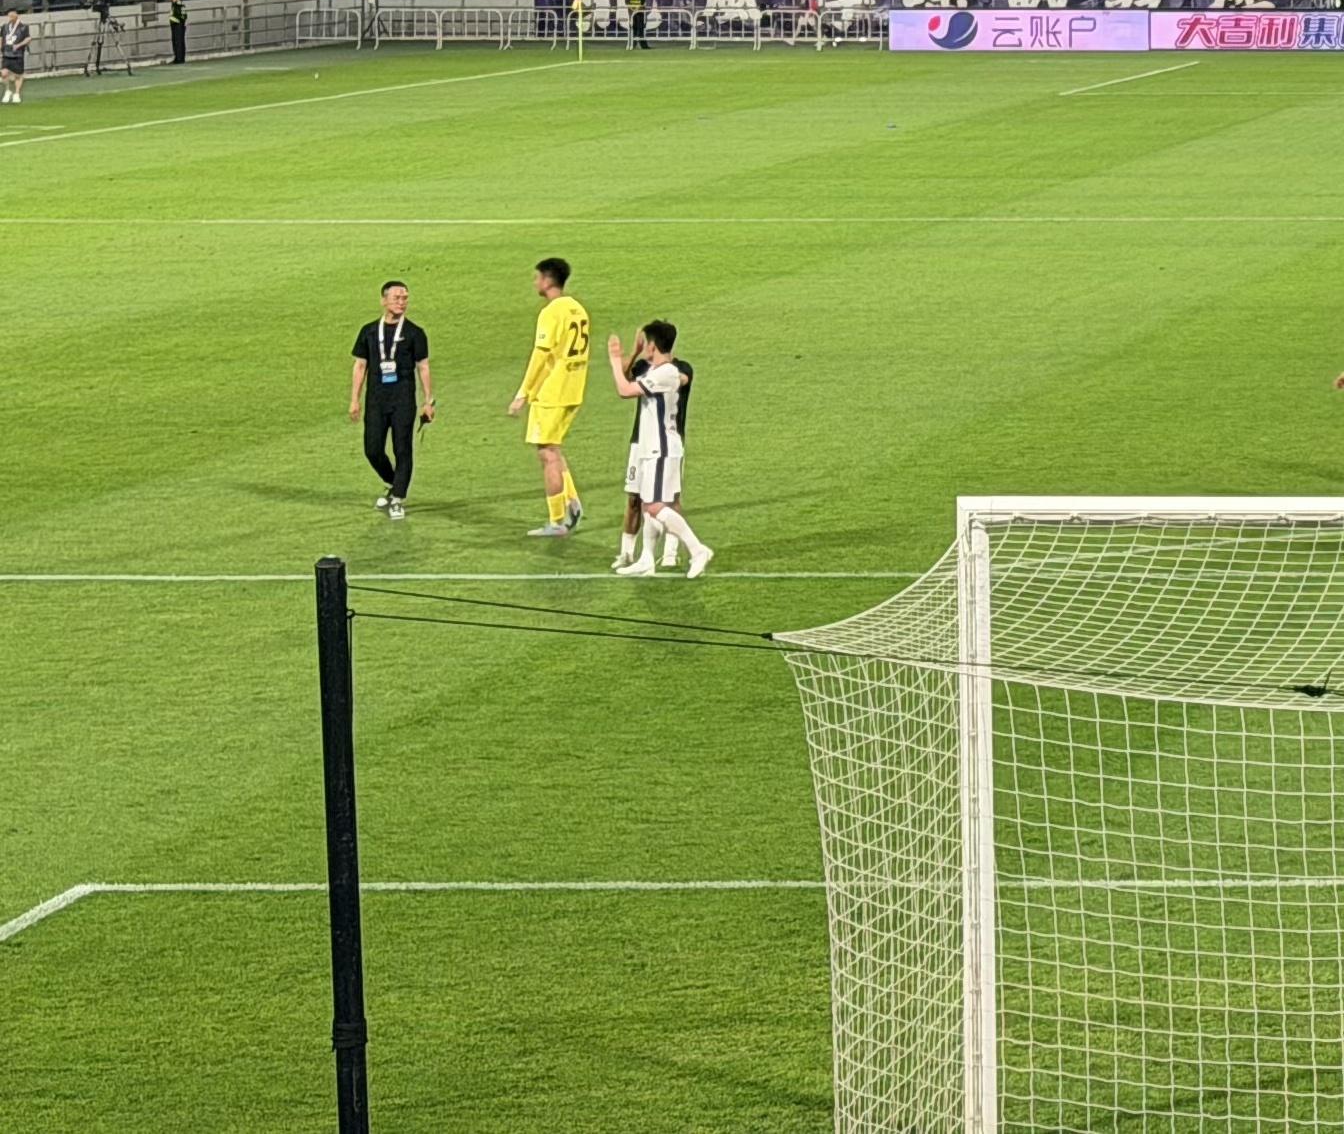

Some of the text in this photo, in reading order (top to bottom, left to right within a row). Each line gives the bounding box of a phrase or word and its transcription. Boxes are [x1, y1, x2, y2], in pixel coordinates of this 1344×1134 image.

[991, 13, 1096, 48] 云账户
[568, 320, 589, 357] 25
